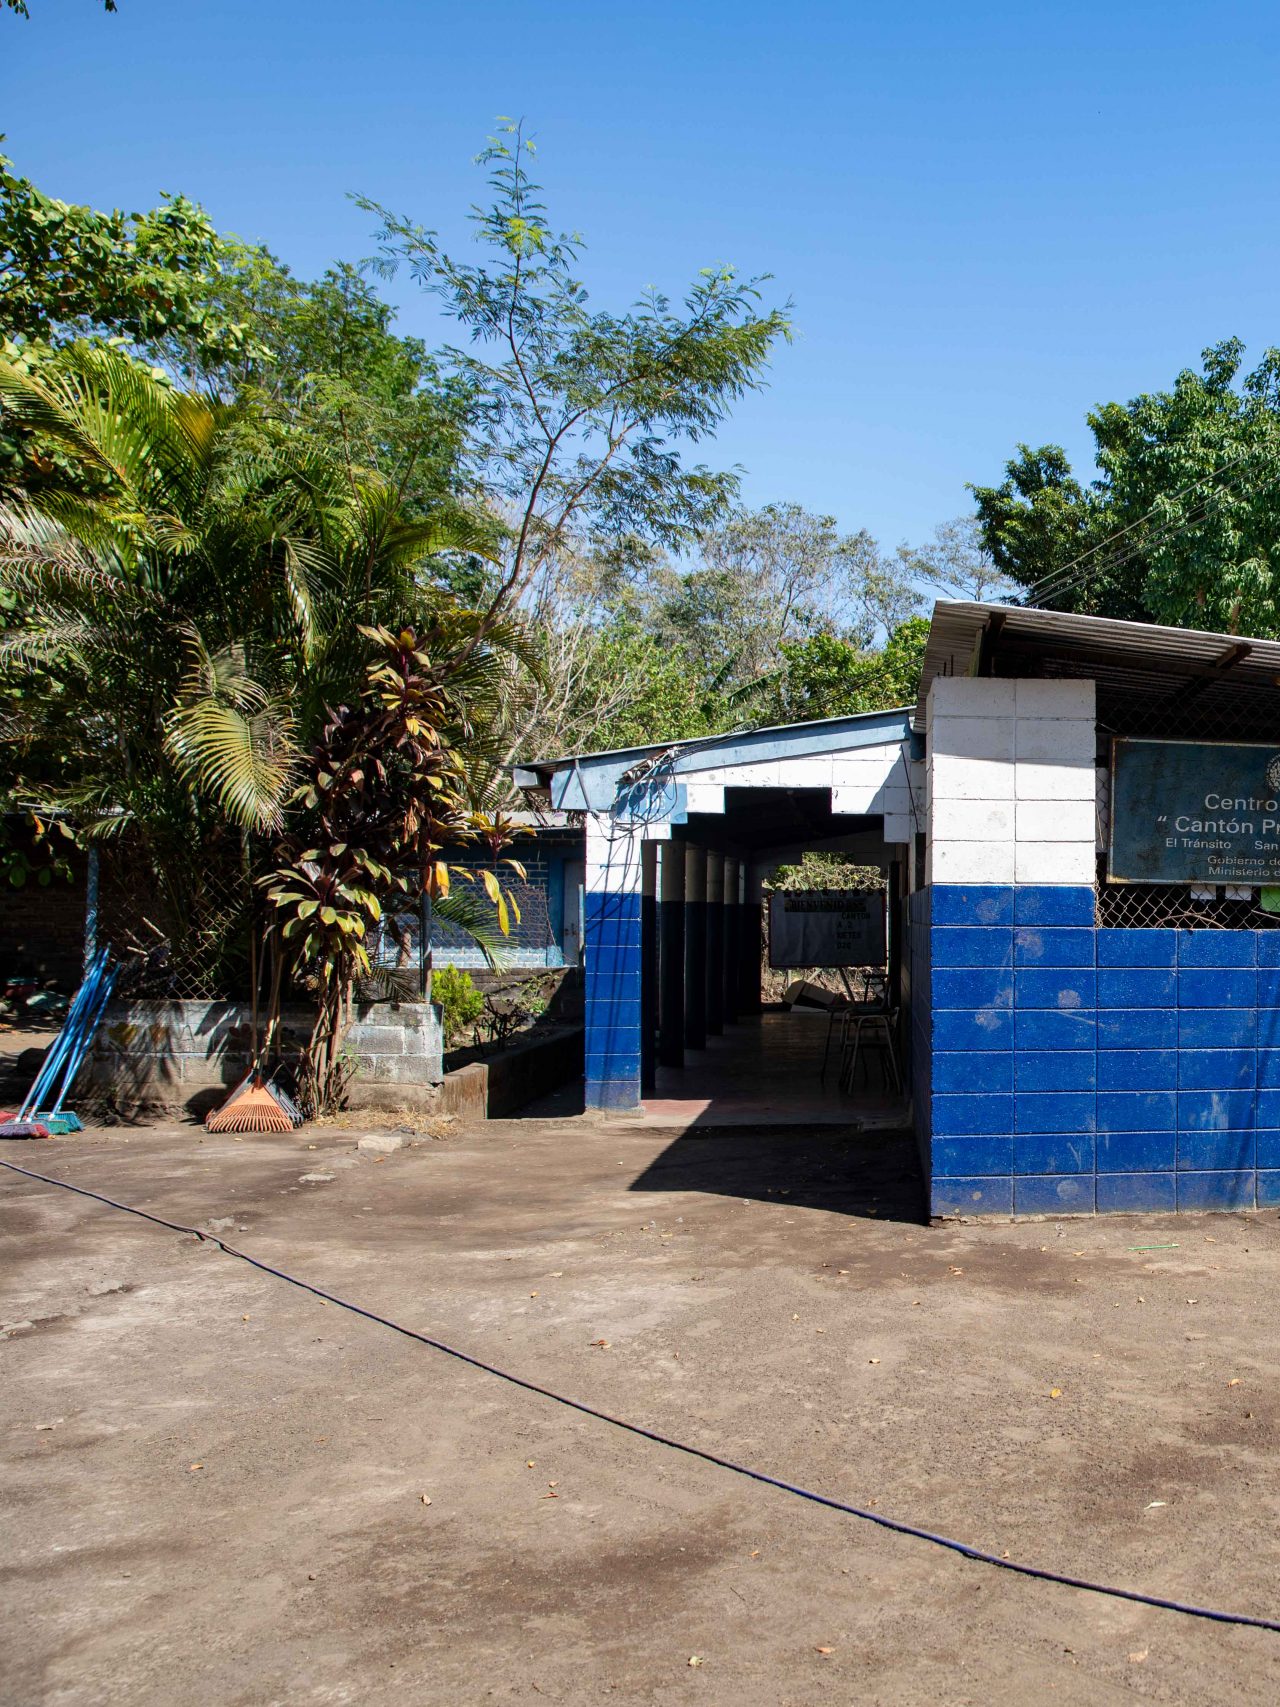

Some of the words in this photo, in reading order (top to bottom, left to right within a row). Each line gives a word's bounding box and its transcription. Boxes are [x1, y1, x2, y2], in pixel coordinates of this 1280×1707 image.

[1204, 793, 1279, 812] Centro
[1175, 816, 1254, 834] Cantón
[1165, 837, 1177, 848] El
[1181, 838, 1232, 849] Tránsito
[1254, 840, 1279, 850] San
[1207, 855, 1265, 866] Gobierno
[1208, 866, 1270, 877] Ministerio
